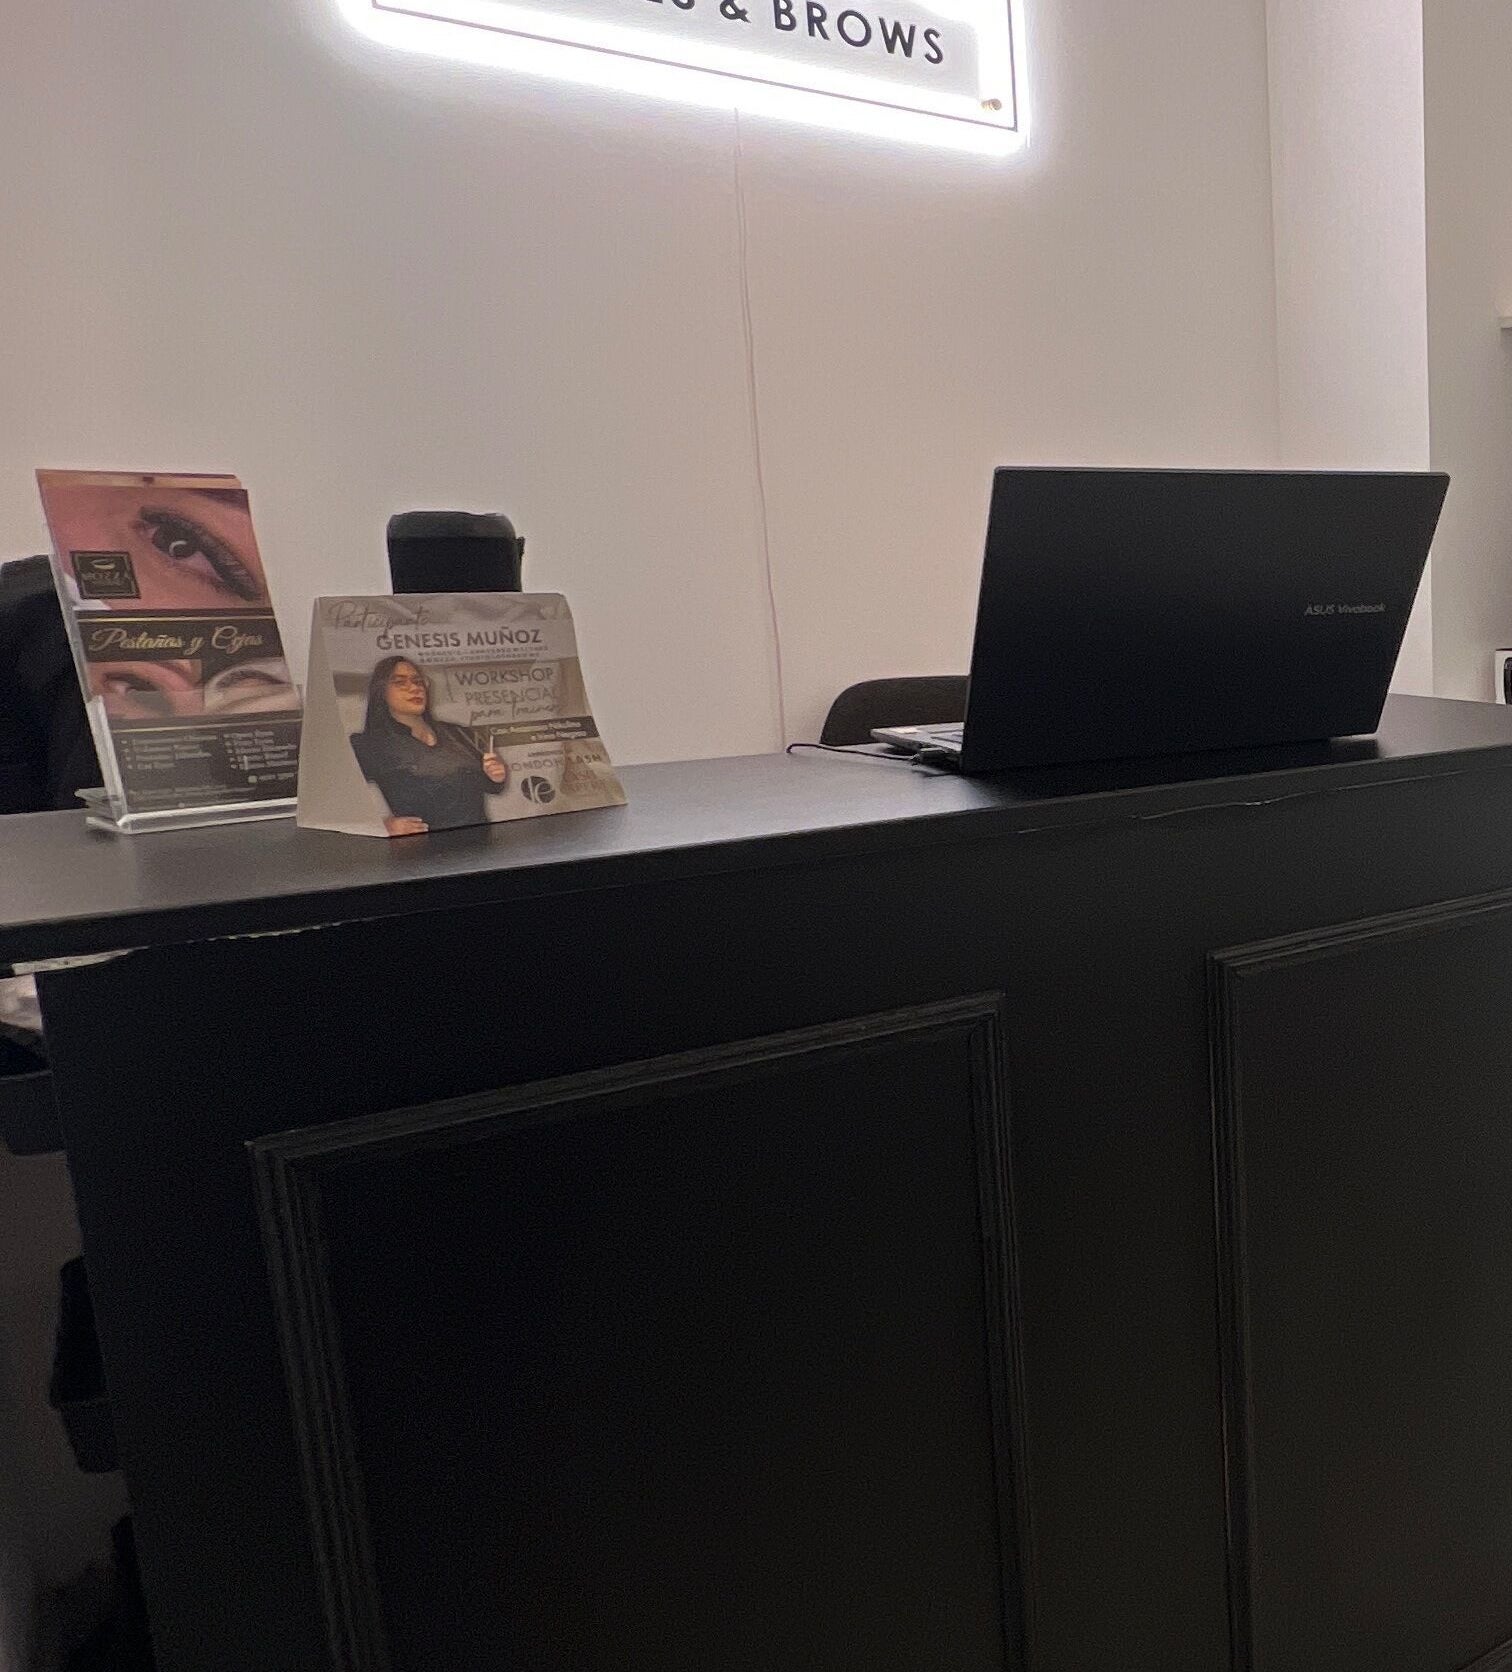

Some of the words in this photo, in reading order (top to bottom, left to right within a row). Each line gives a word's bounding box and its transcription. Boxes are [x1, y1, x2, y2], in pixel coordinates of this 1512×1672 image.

[773, 0, 944, 64] BROWS
[1304, 604, 1336, 616] ASUS
[185, 635, 204, 656] y
[376, 631, 461, 651] GENESIS
[467, 626, 543, 647] MUÑOZ
[455, 667, 554, 686] WORKSHOP
[464, 687, 558, 706] PRESENCIAL
